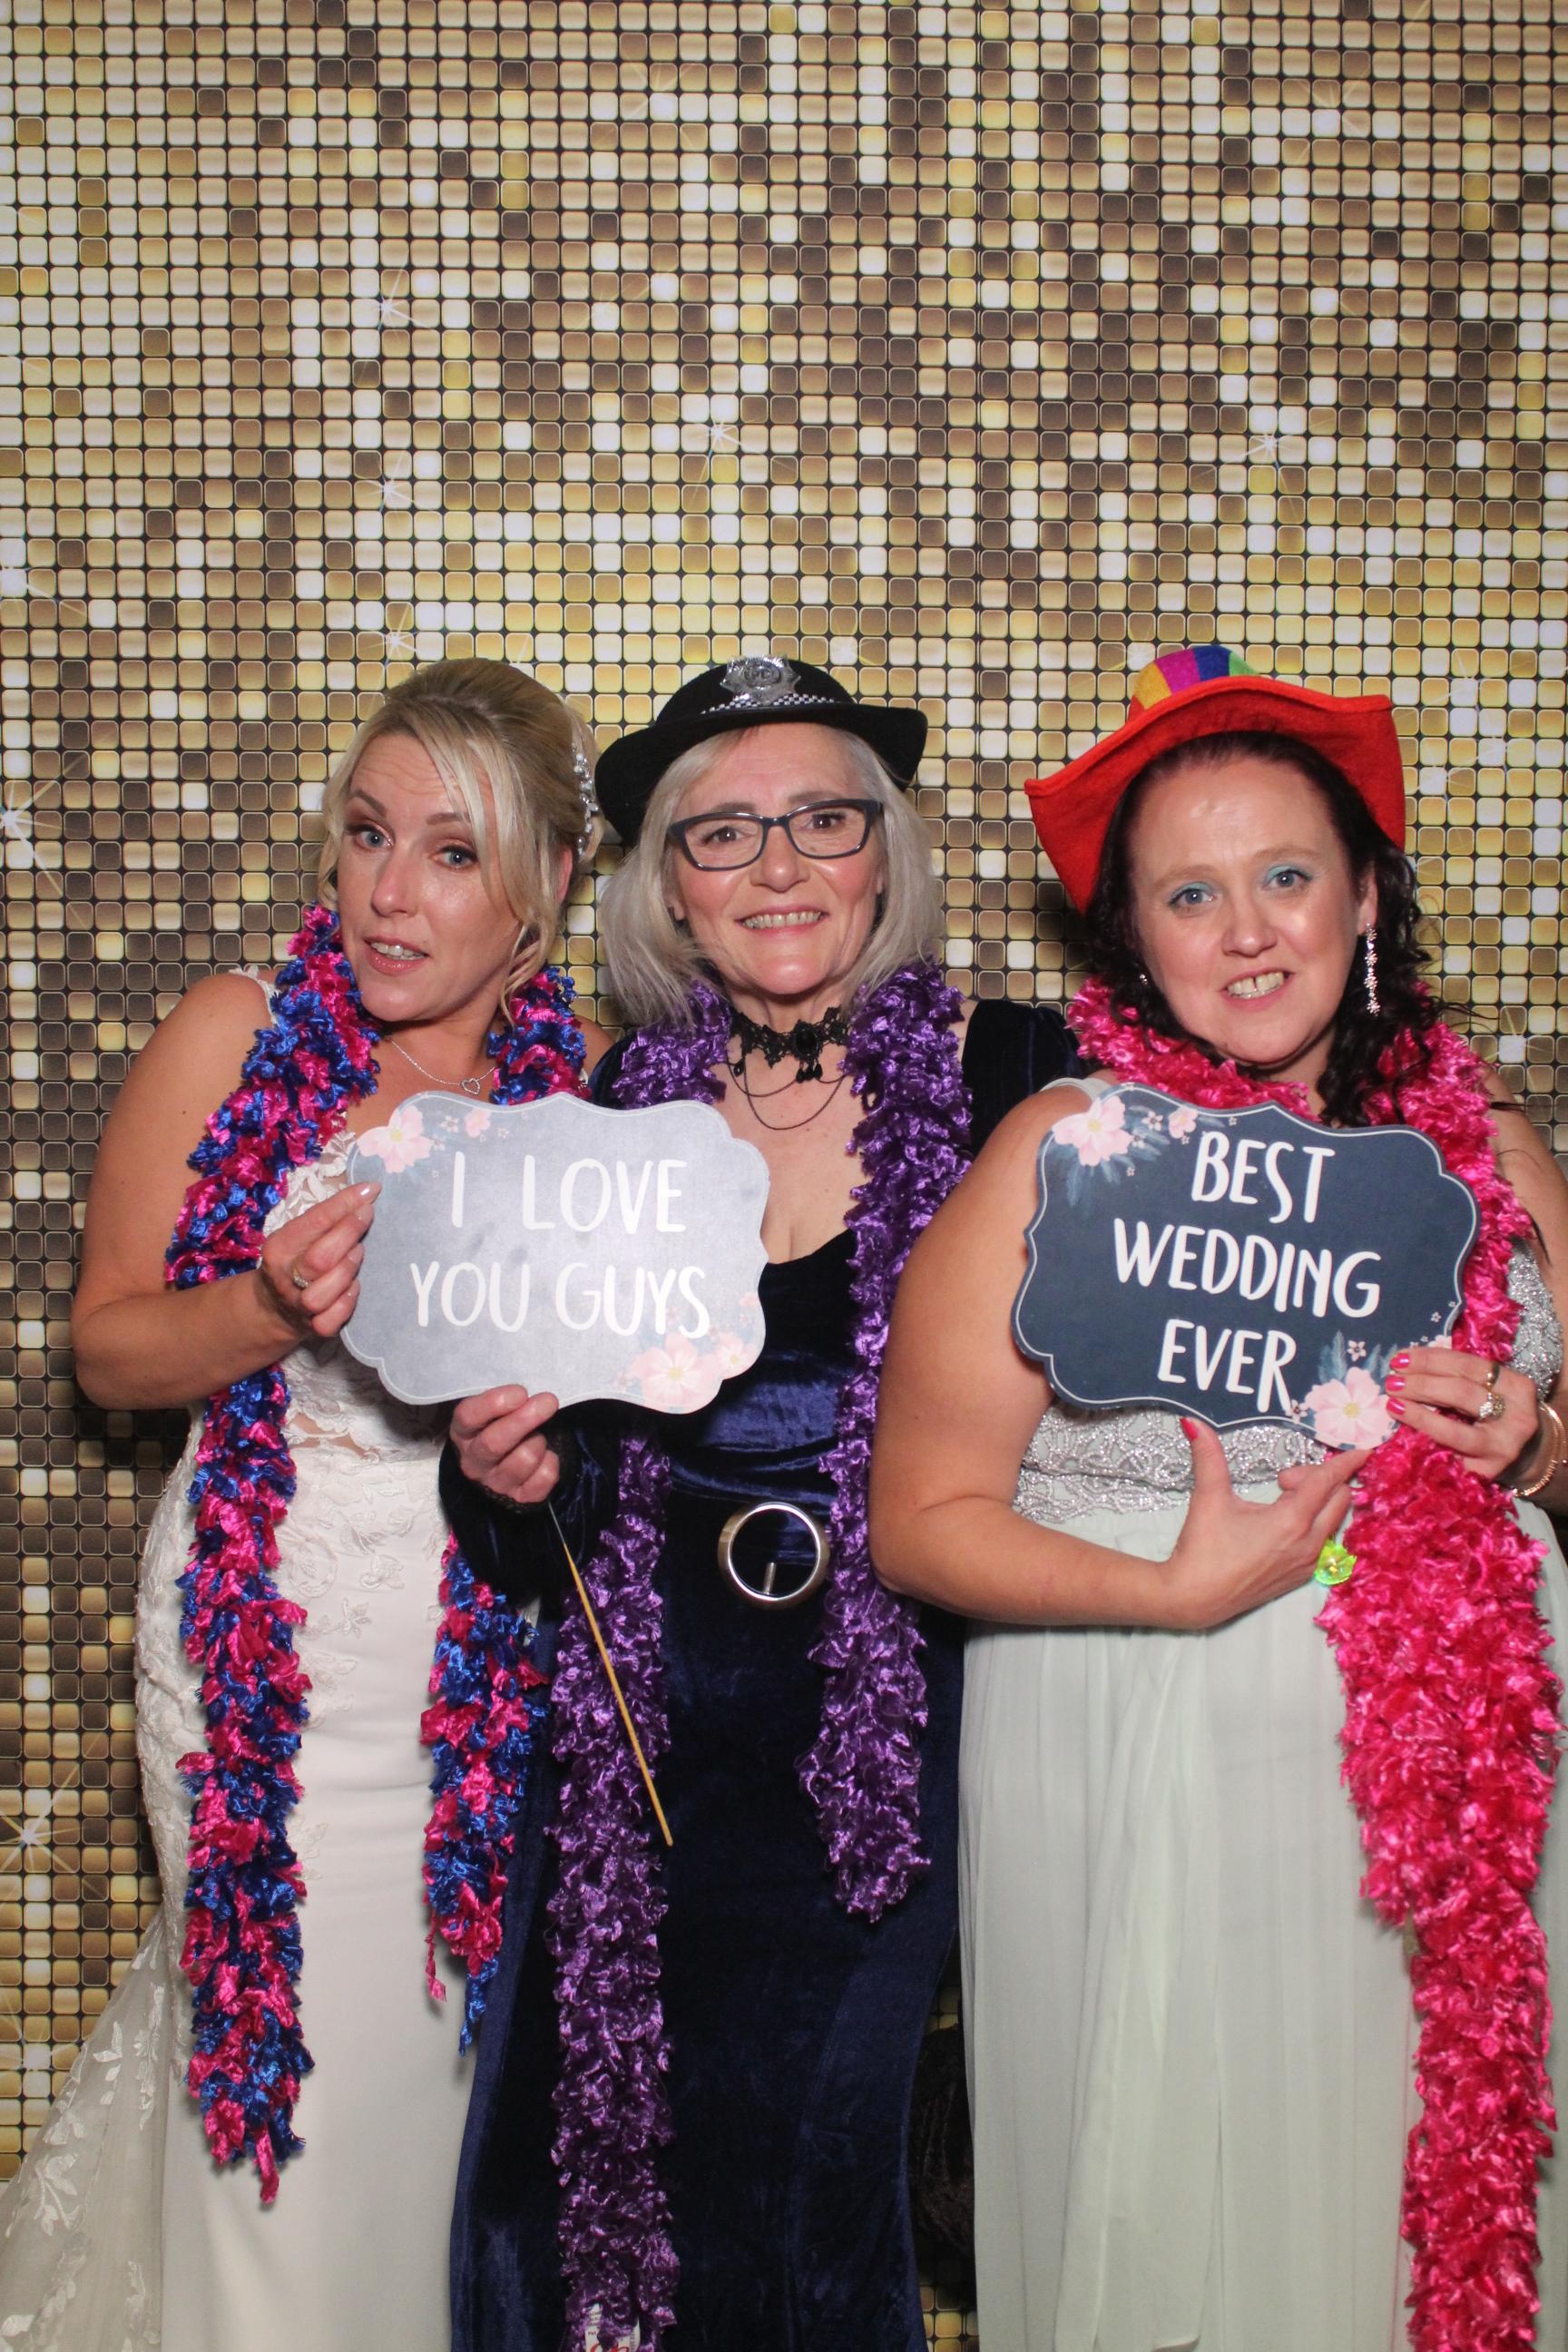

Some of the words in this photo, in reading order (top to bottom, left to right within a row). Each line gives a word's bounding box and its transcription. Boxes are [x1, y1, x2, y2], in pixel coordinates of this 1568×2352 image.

[452, 1152, 466, 1228] I
[522, 1155, 687, 1234] LOVE
[1191, 1132, 1336, 1223] BEST
[410, 1261, 530, 1332] YOU
[555, 1262, 710, 1338] GUYS
[1114, 1218, 1381, 1318] WEDDING
[1157, 1318, 1296, 1413] EVER
